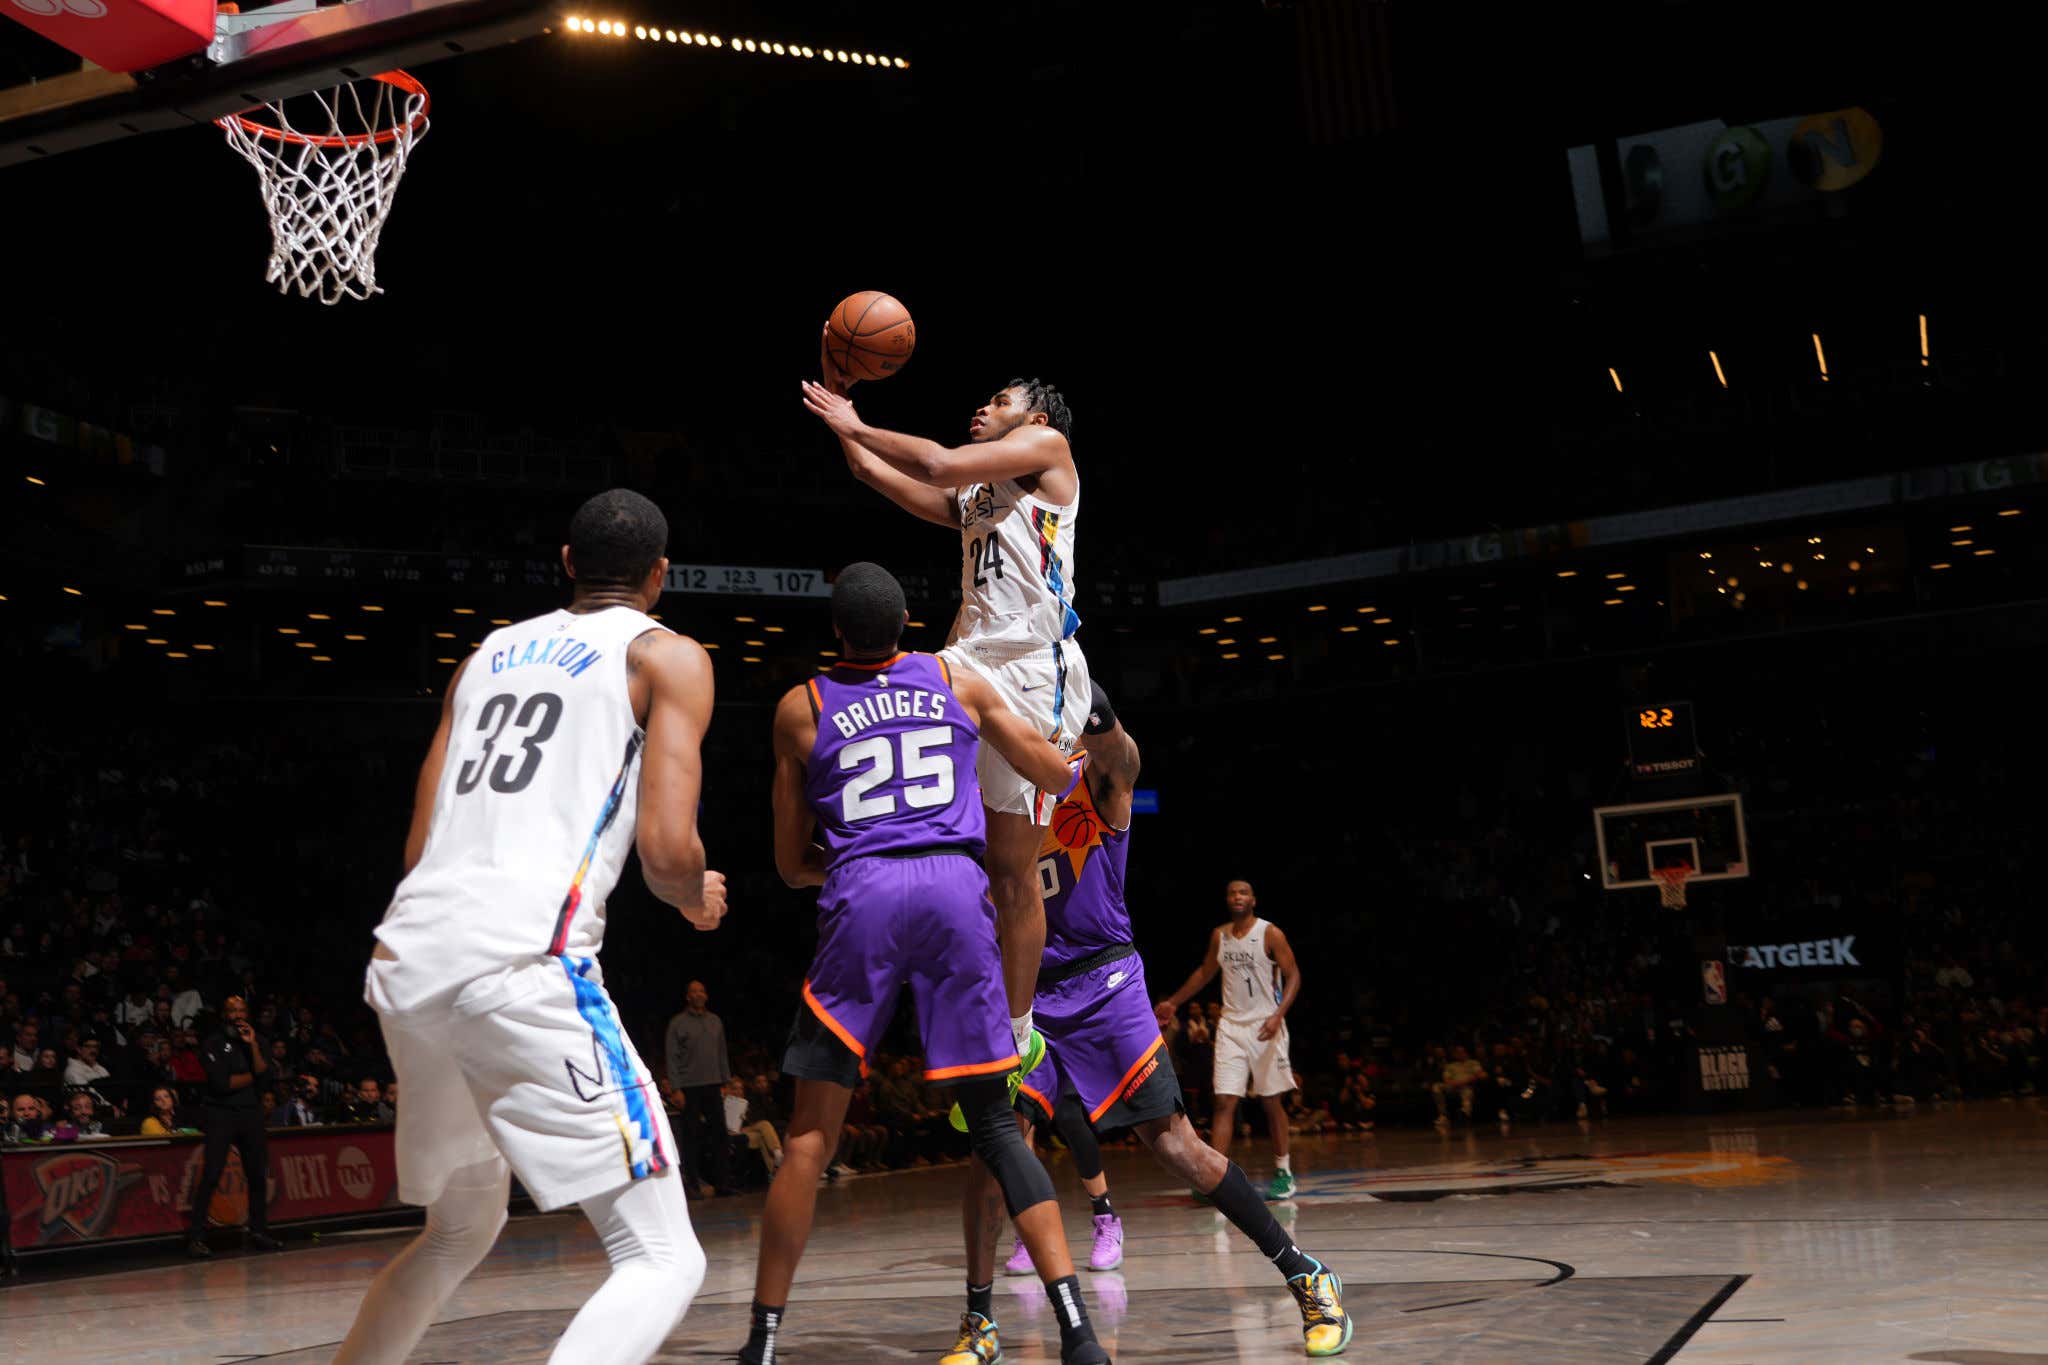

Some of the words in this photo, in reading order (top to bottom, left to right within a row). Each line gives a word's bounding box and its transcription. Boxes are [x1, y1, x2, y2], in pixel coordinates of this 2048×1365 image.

[668, 569, 707, 589] 112
[723, 570, 756, 584] 12.3
[774, 572, 815, 592] 107
[970, 531, 1004, 587] 24
[492, 638, 601, 678] CLAXTON
[831, 690, 947, 738] BRIDGES
[456, 692, 563, 795] 33
[838, 725, 955, 822] 25
[1244, 977, 1253, 998] 1
[280, 1153, 333, 1201] NEXT
